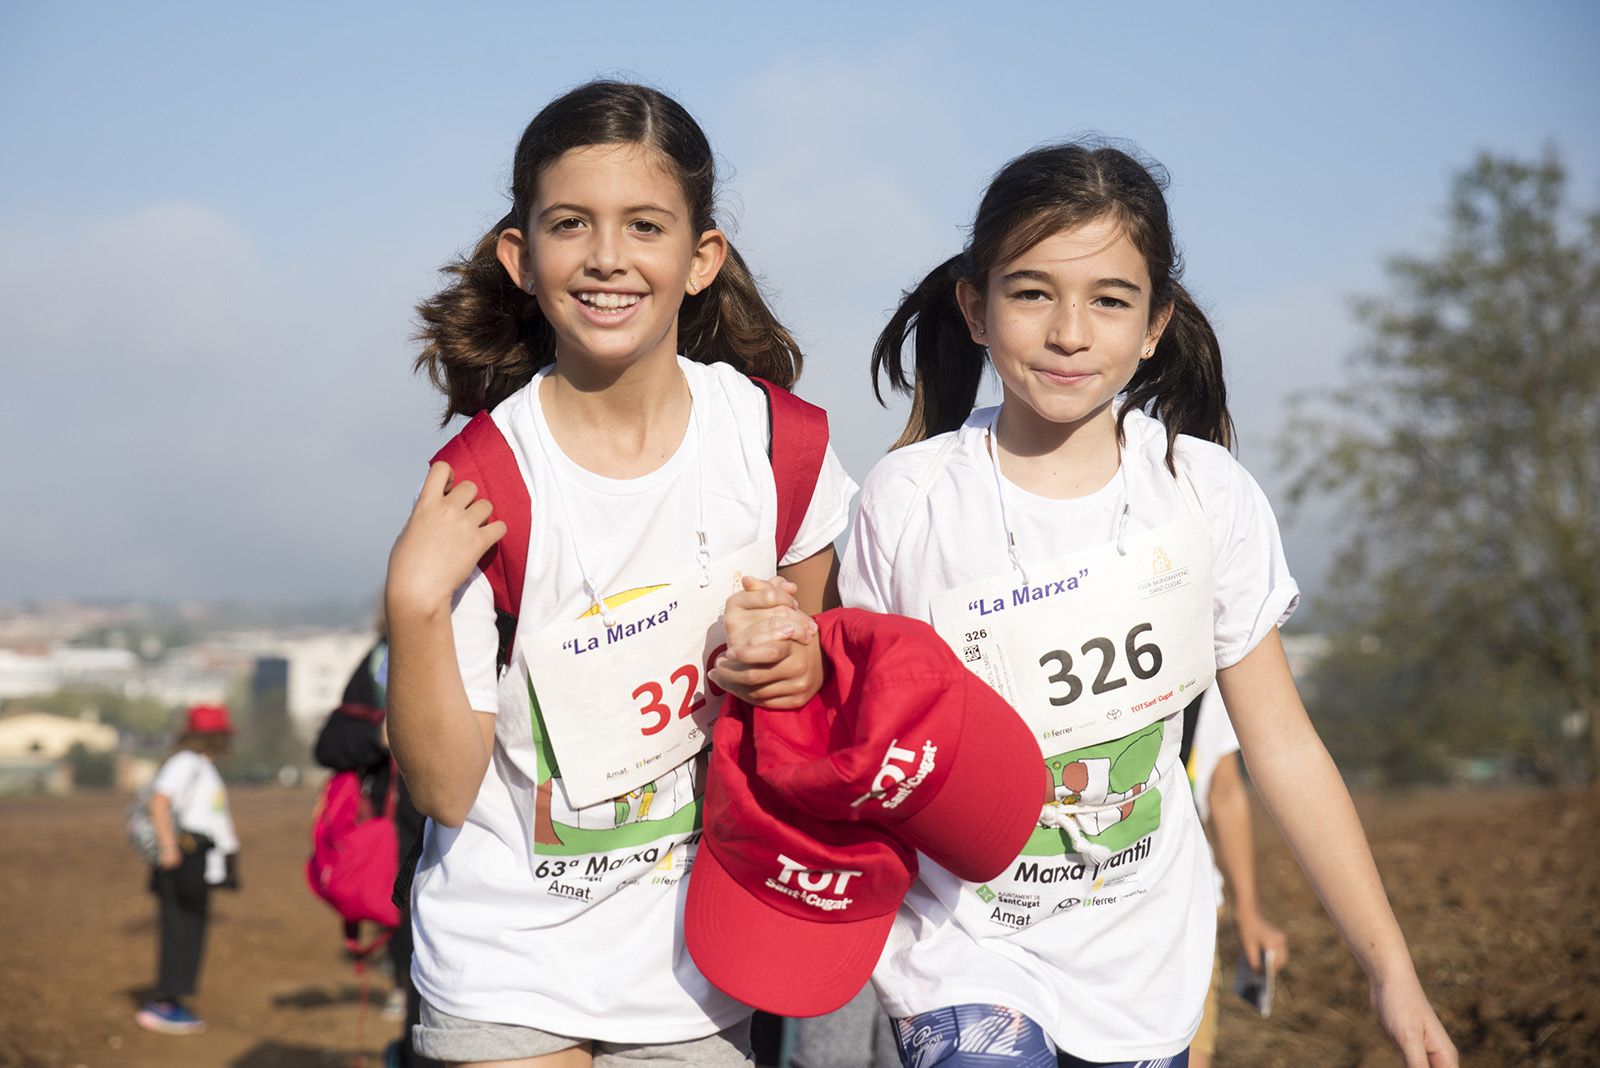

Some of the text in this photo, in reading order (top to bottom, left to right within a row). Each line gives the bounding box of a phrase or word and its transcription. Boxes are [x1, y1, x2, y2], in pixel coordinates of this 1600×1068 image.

[965, 629, 987, 642] 326
[1038, 622, 1163, 707] 326
[1051, 726, 1073, 738] ferrer
[643, 752, 663, 765] ferrer
[585, 847, 659, 877] Marxa
[777, 854, 864, 895] TOT
[1013, 862, 1085, 884] Marxa
[805, 893, 853, 911] Cugat
[998, 895, 1041, 909] SantCugat
[1091, 896, 1118, 907] ferrer
